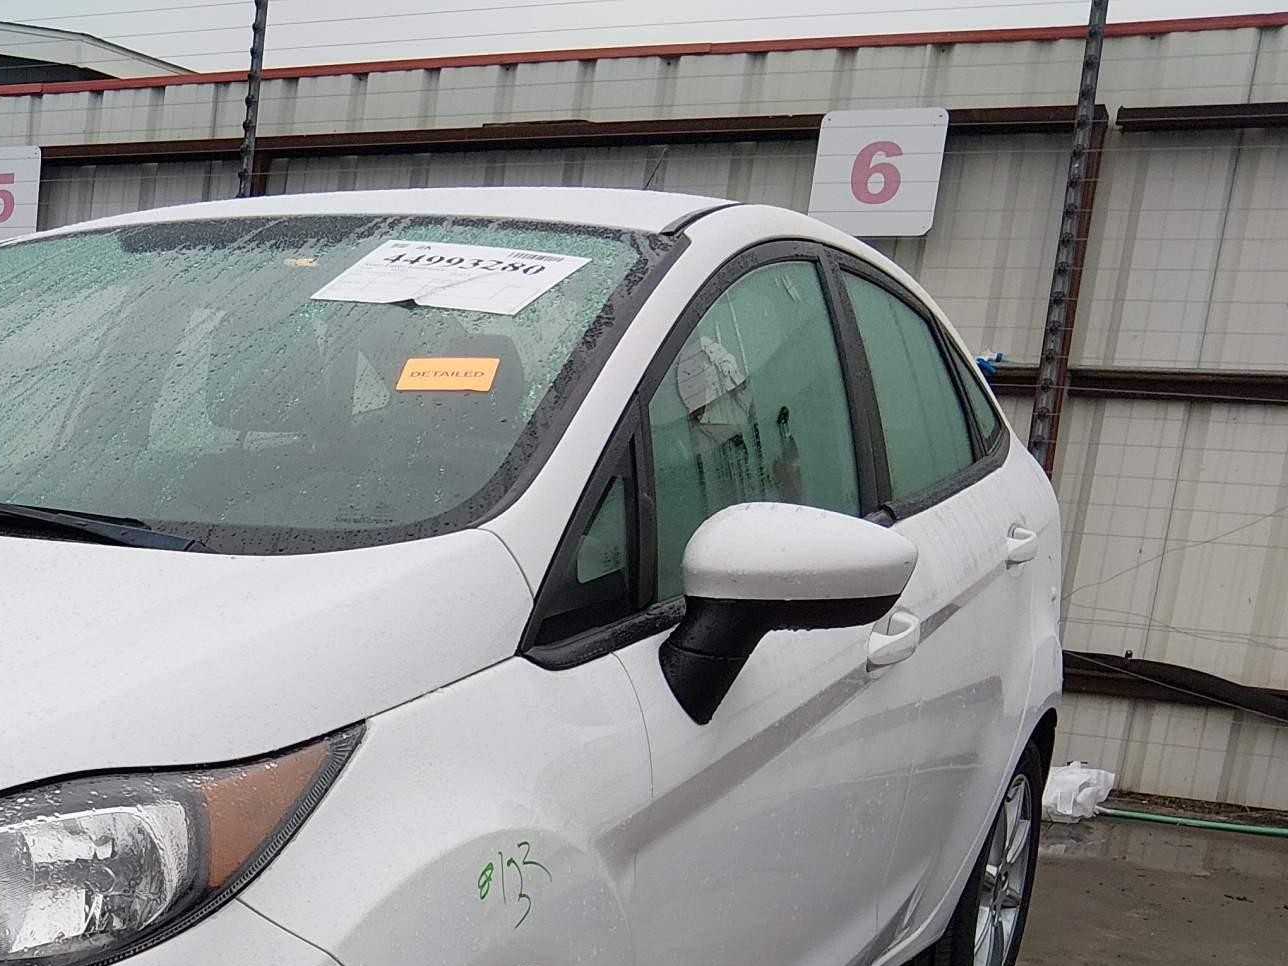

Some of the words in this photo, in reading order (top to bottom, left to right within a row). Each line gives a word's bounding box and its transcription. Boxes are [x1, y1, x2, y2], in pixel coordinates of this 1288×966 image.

[850, 140, 904, 205] 6
[383, 252, 545, 276] 44993280
[408, 370, 486, 379] DETAILED
